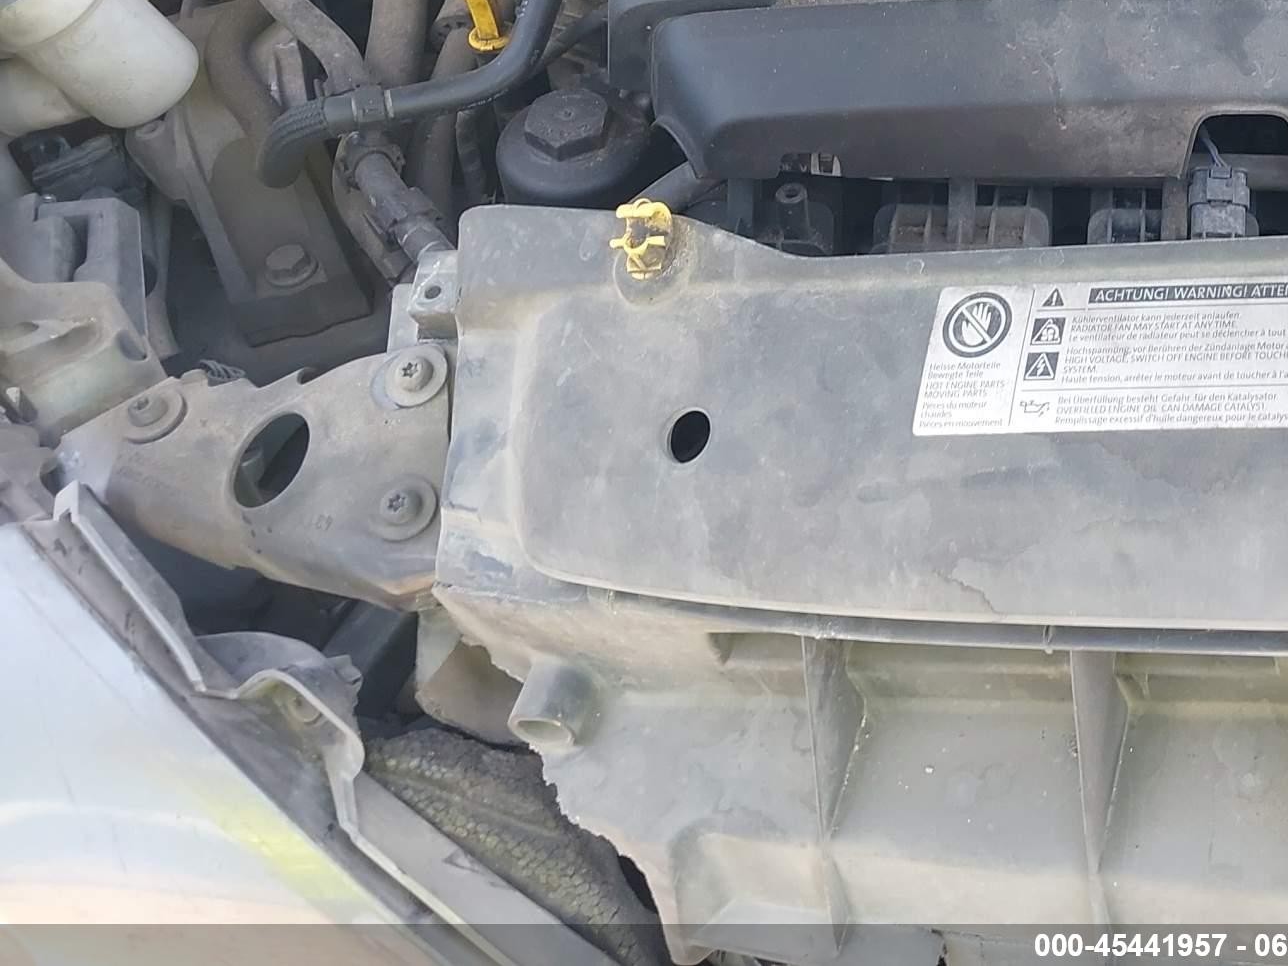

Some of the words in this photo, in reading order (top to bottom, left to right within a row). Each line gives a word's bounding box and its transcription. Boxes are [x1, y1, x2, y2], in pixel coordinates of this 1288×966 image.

[1093, 287, 1170, 303] ACHTUNG!
[1174, 284, 1248, 300] WARNING!
[1141, 313, 1160, 321] kann
[1071, 324, 1114, 332] RADIATOR
[1155, 322, 1179, 330] START
[1194, 321, 1212, 329] ANY
[1179, 331, 1198, 339] peut
[1188, 343, 1202, 351] der
[1257, 342, 1284, 350] Motor
[1064, 356, 1087, 364] HIGH
[1131, 354, 1163, 362] SWITCH
[1184, 353, 1216, 361] ENGINE
[1219, 352, 1251, 361] BEFORE
[1198, 371, 1221, 379] avant
[1208, 393, 1225, 401] den
[1161, 403, 1179, 411] CAN
[1182, 402, 1221, 411] DAMAGE
